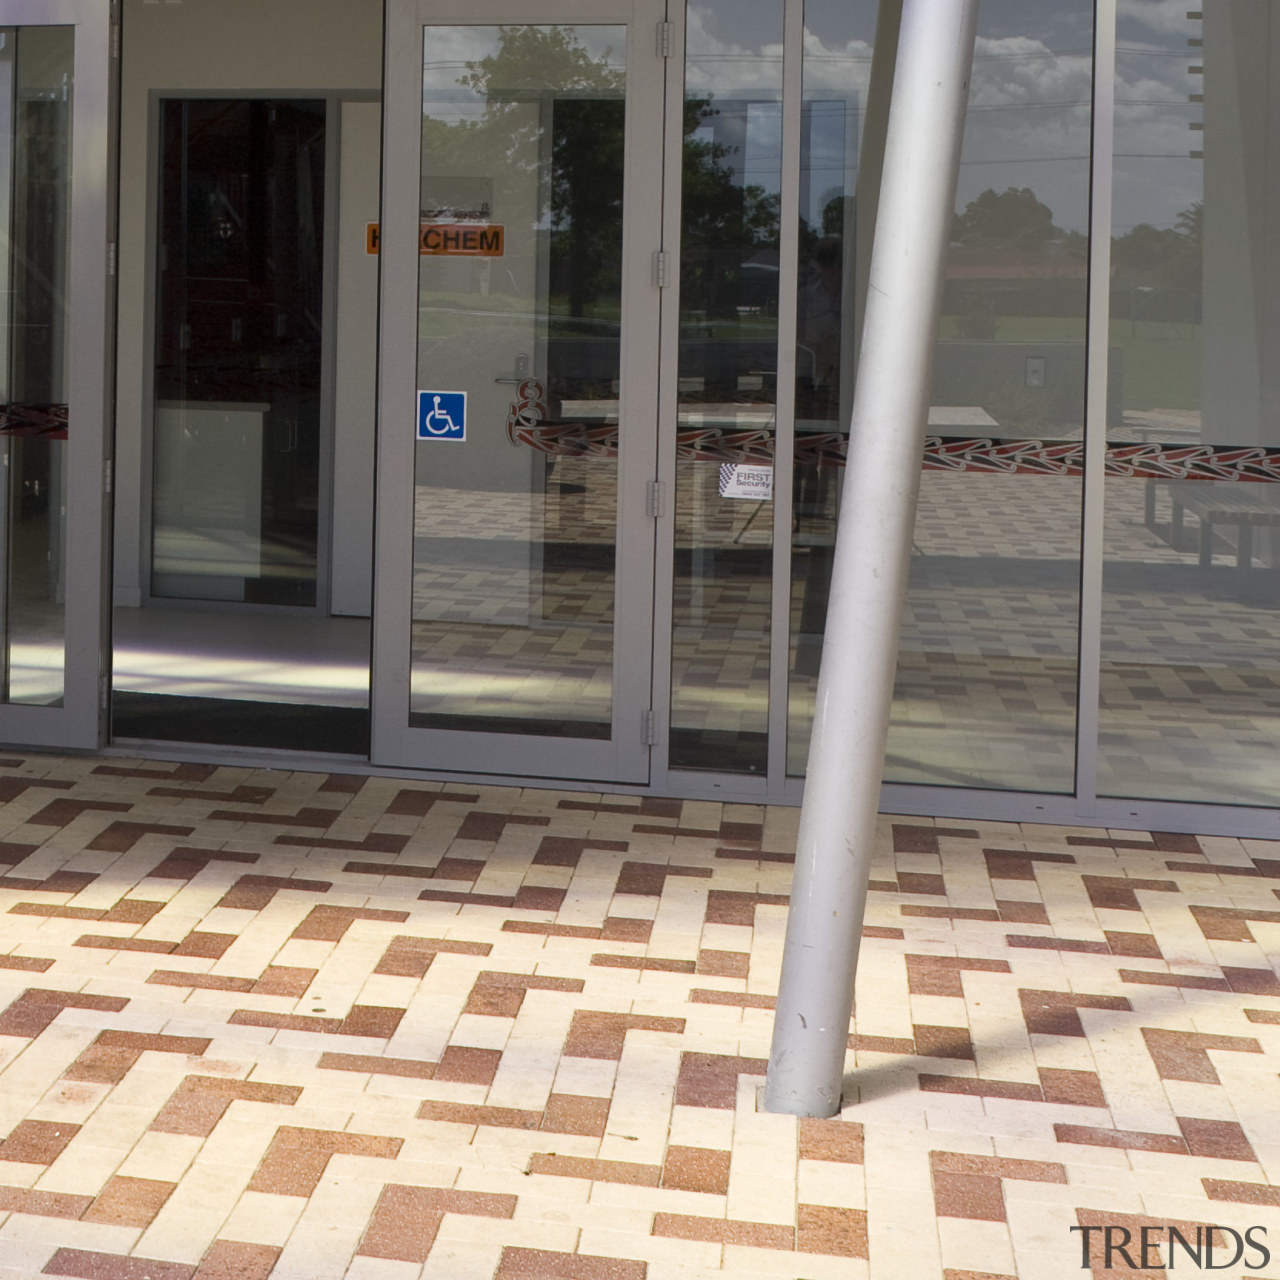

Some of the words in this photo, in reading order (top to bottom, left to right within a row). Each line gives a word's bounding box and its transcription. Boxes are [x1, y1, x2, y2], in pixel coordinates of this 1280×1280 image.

[371, 229, 500, 251] CHEM
[736, 472, 771, 482] FIRST
[736, 479, 771, 489] Security
